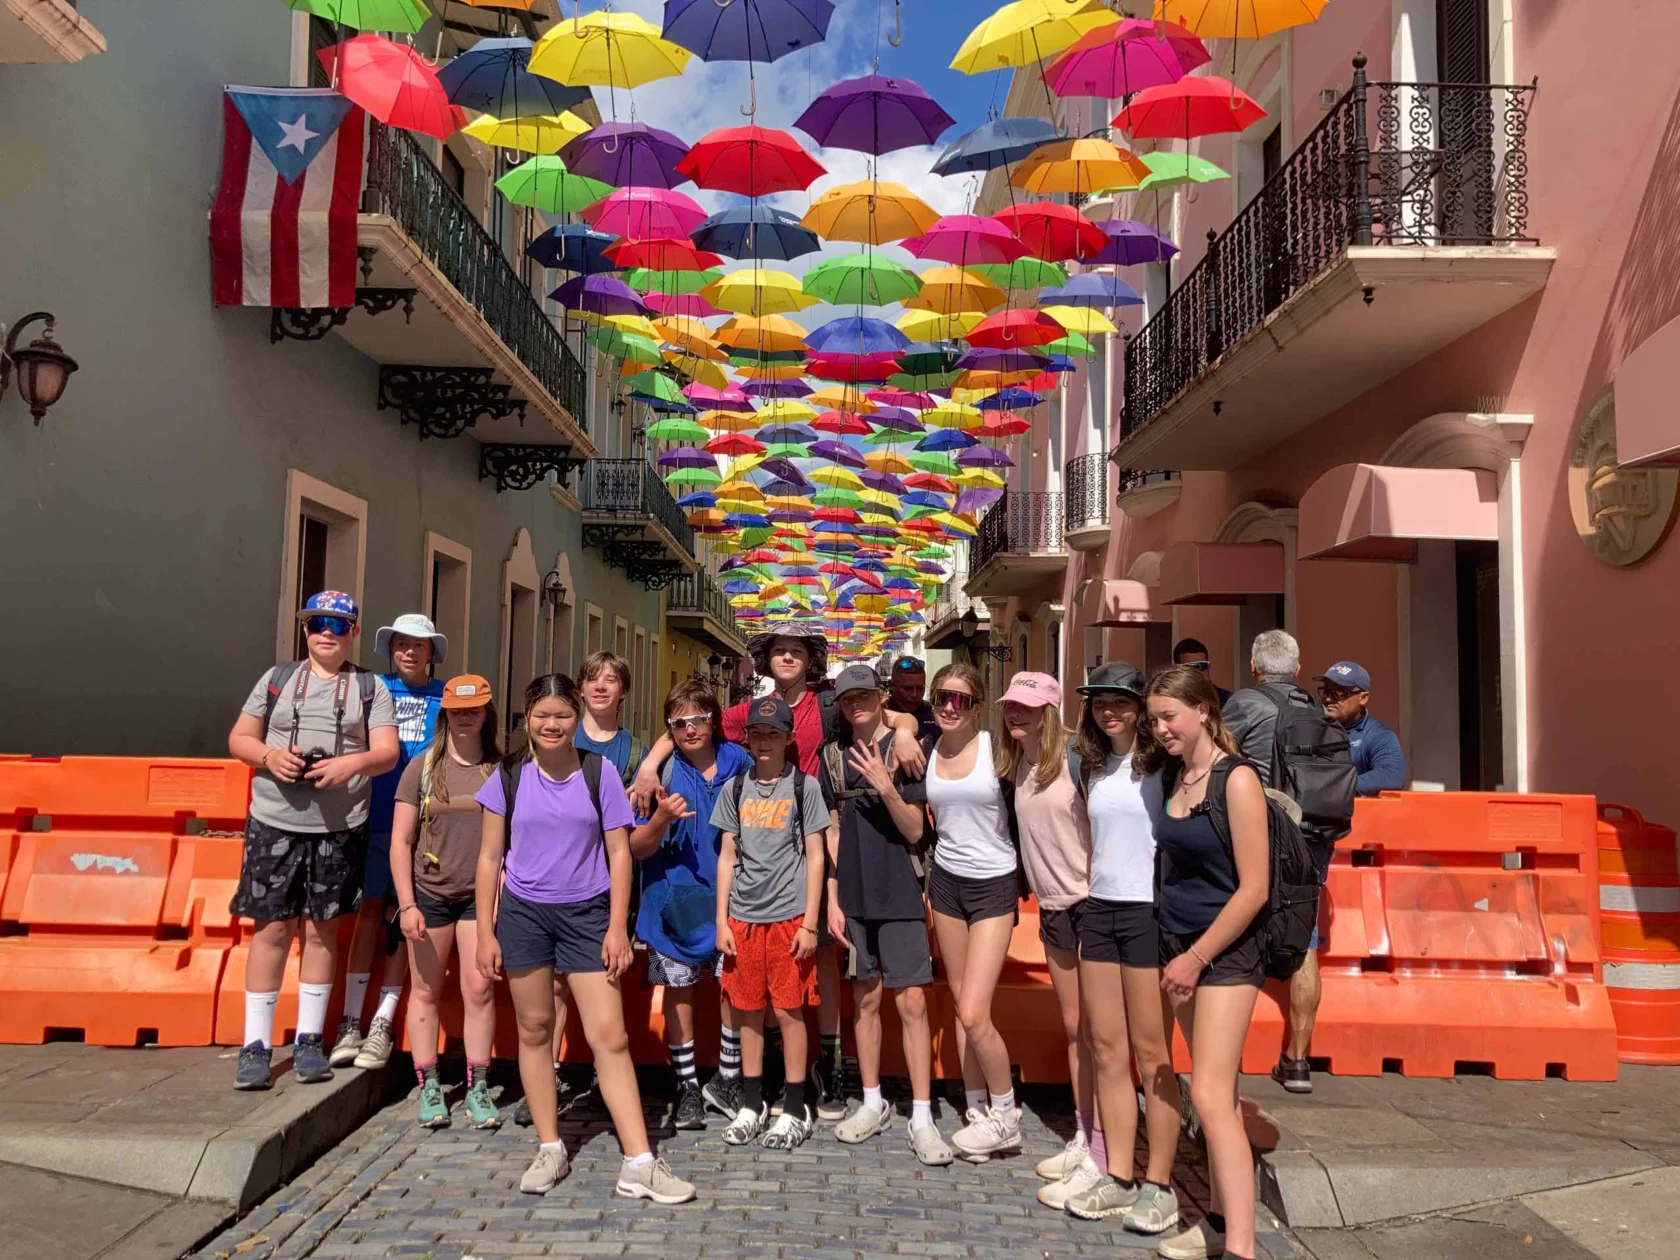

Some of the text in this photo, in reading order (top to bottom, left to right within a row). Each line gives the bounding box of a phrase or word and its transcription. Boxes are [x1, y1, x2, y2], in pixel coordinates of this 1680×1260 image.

[296, 670, 307, 695] DIGITAL
[338, 679, 347, 700] Canon
[396, 702, 424, 715] NIKE
[740, 798, 793, 829] NIKE
[722, 1047, 741, 1056] STAN
